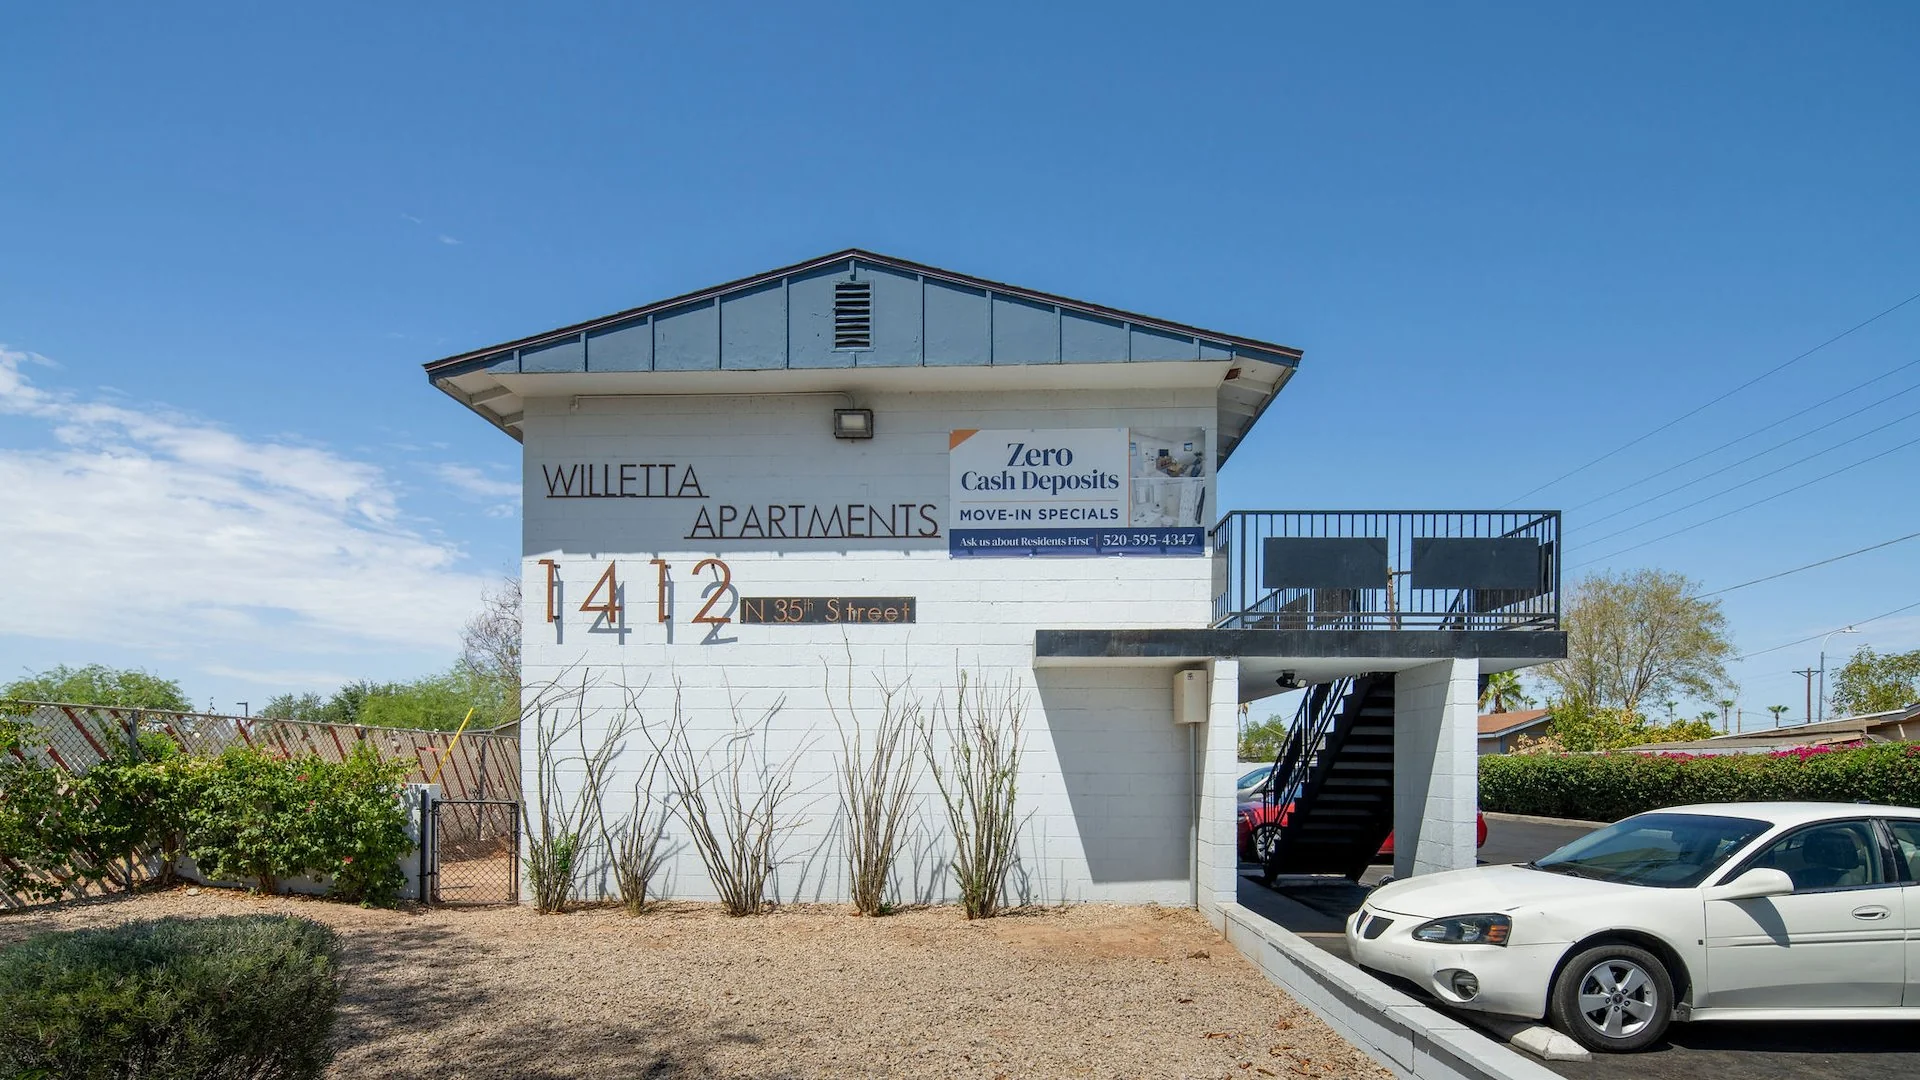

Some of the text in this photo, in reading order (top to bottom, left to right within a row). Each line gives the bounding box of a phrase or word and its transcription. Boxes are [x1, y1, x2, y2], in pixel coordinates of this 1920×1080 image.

[1007, 442, 1073, 467] Zero
[542, 464, 704, 497] WILLETTA
[961, 469, 1119, 495] Cash Deposits
[690, 504, 939, 538] APARTMENTS
[960, 508, 1119, 521] MOVE-IN SPECIALS
[960, 537, 978, 547] Ask
[979, 539, 990, 547] us
[992, 537, 1019, 547] about
[1021, 536, 1067, 546] Residents
[1103, 533, 1196, 547] 520-595-4347
[538, 558, 732, 624] 1412
[745, 598, 910, 622] N 35th Street
